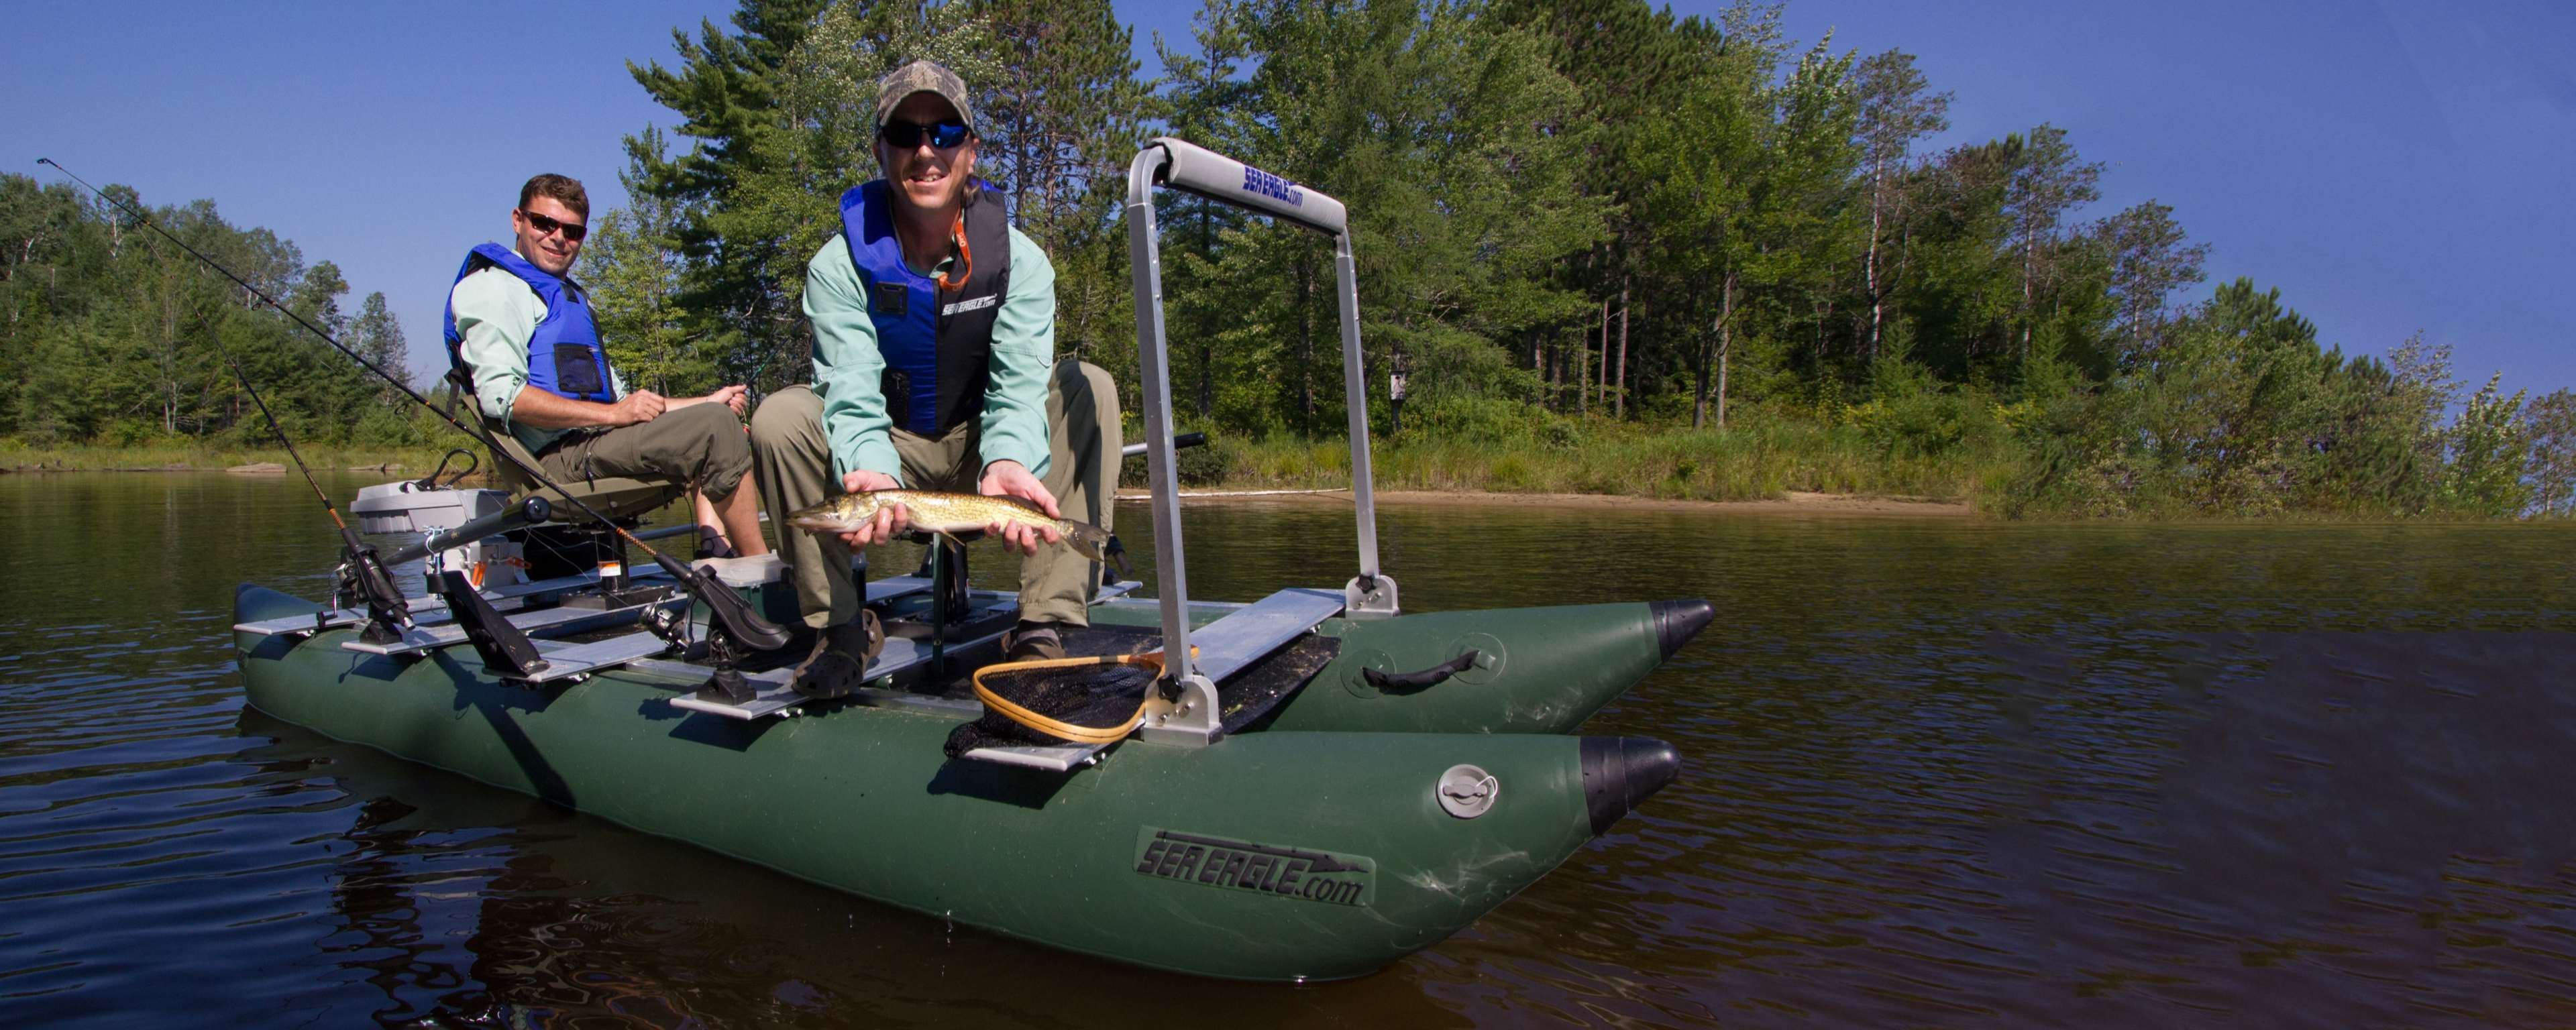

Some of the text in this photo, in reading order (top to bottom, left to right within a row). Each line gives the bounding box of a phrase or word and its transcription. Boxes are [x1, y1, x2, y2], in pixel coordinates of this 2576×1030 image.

[1242, 166, 1303, 207] SEA EAGLE.com
[943, 304, 959, 316] SEA
[1137, 840, 1364, 903] SEA EAGLE.com
